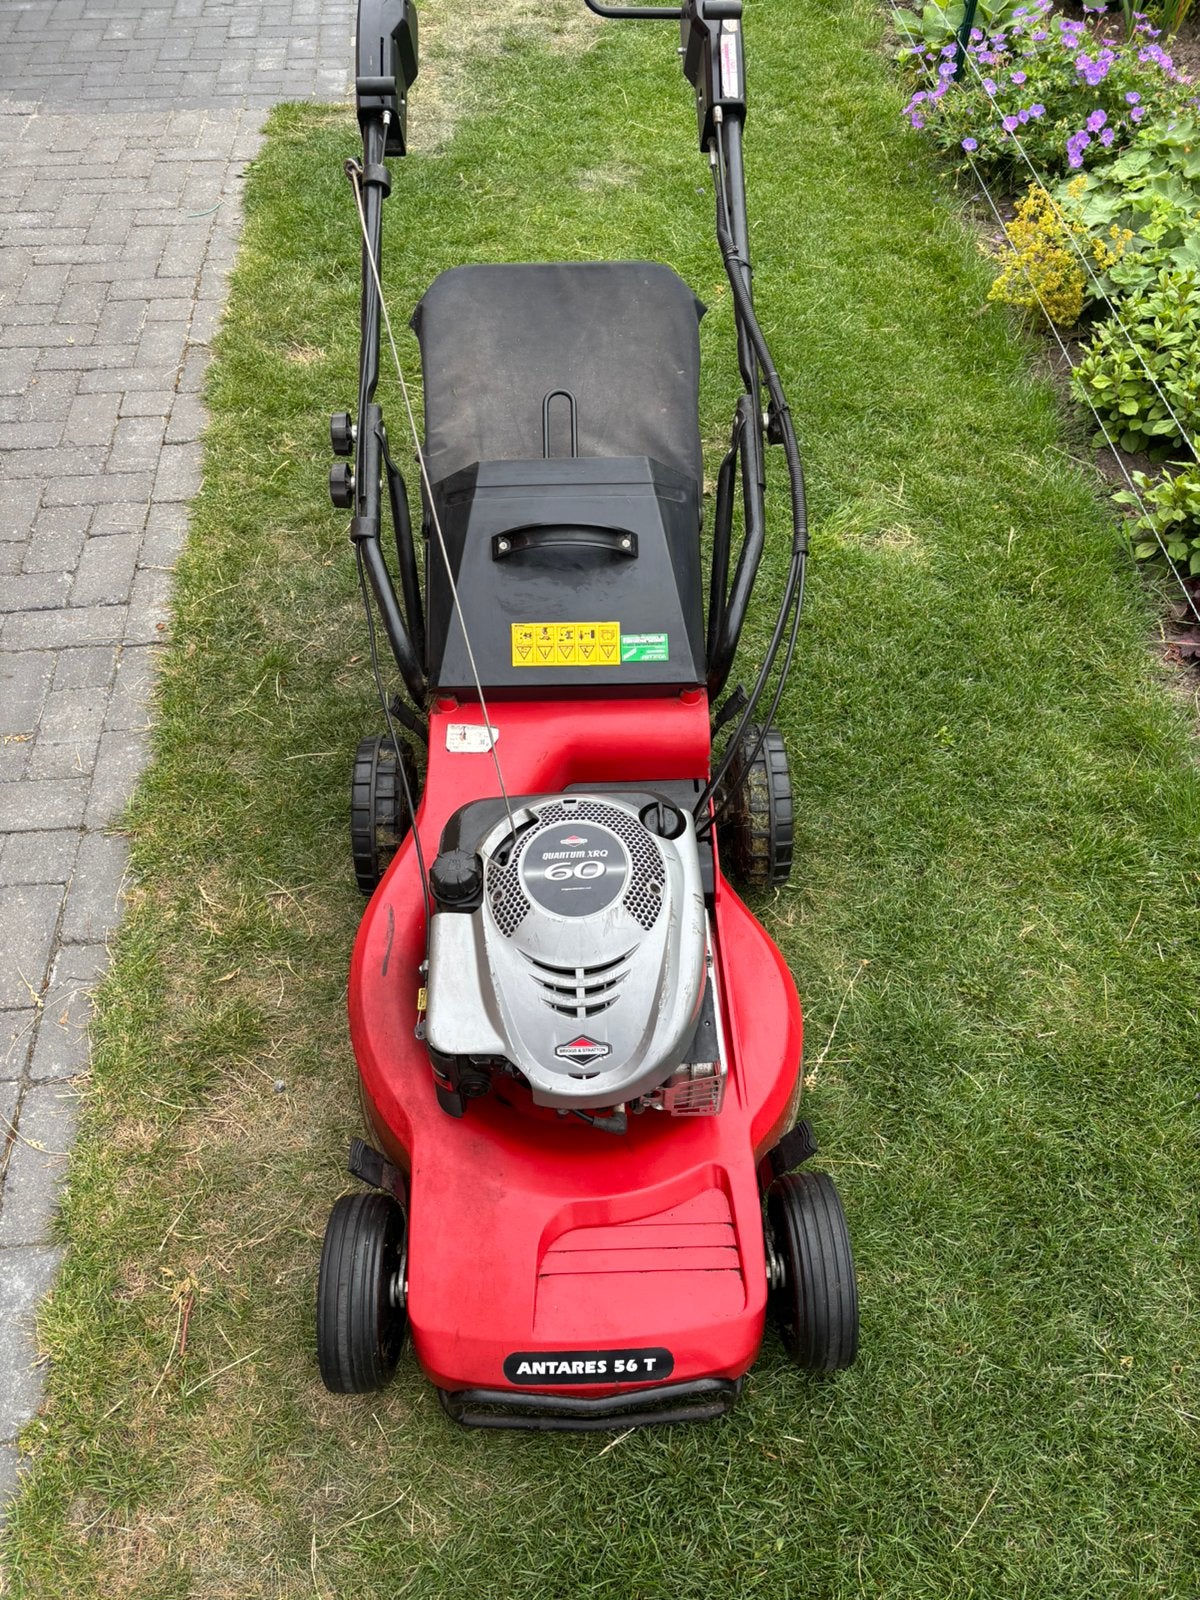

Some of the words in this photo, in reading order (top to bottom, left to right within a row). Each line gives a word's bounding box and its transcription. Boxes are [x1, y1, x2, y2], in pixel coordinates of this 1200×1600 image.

[542, 851, 585, 860] QUANTUM
[587, 849, 608, 858] XRQ
[544, 861, 606, 881] 60
[516, 1360, 607, 1375] ANTARES
[614, 1359, 638, 1373] 56
[643, 1358, 656, 1371] T
